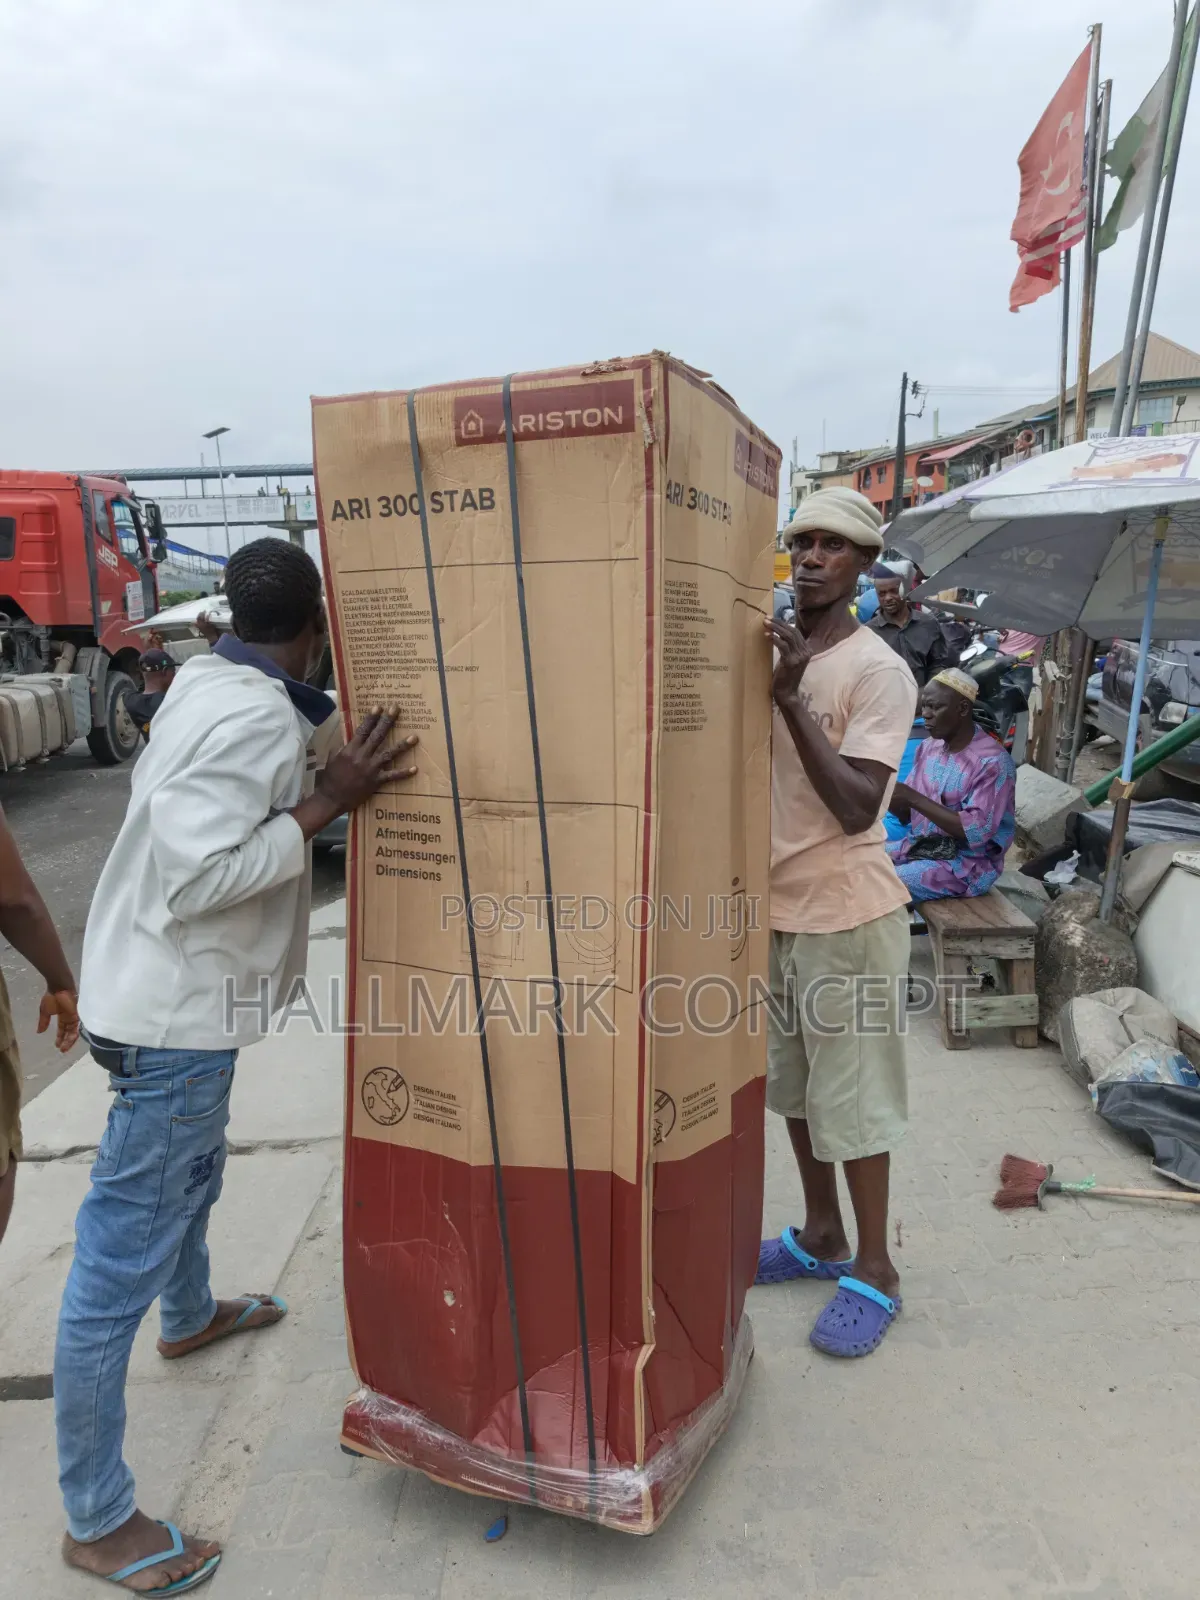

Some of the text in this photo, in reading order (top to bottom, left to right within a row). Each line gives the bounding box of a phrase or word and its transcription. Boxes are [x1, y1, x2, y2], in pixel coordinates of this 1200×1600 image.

[498, 406, 624, 435] ARISTON
[331, 487, 496, 522] ARI 300 STAB
[666, 480, 732, 526] ARI 300 STAB
[342, 597, 369, 605] ELECTRIC
[370, 595, 388, 603] WATER
[346, 628, 365, 636] TERMO
[375, 808, 442, 825] Dimensions
[375, 827, 442, 845] Afmetingen
[375, 846, 456, 866] Abmessungen
[375, 864, 442, 882] Dimensions
[413, 1084, 457, 1101] DESIGN ITALIEN
[414, 1098, 457, 1116] ITALIAN DESIGN
[413, 1112, 462, 1131] DESIGN ITALIANO
